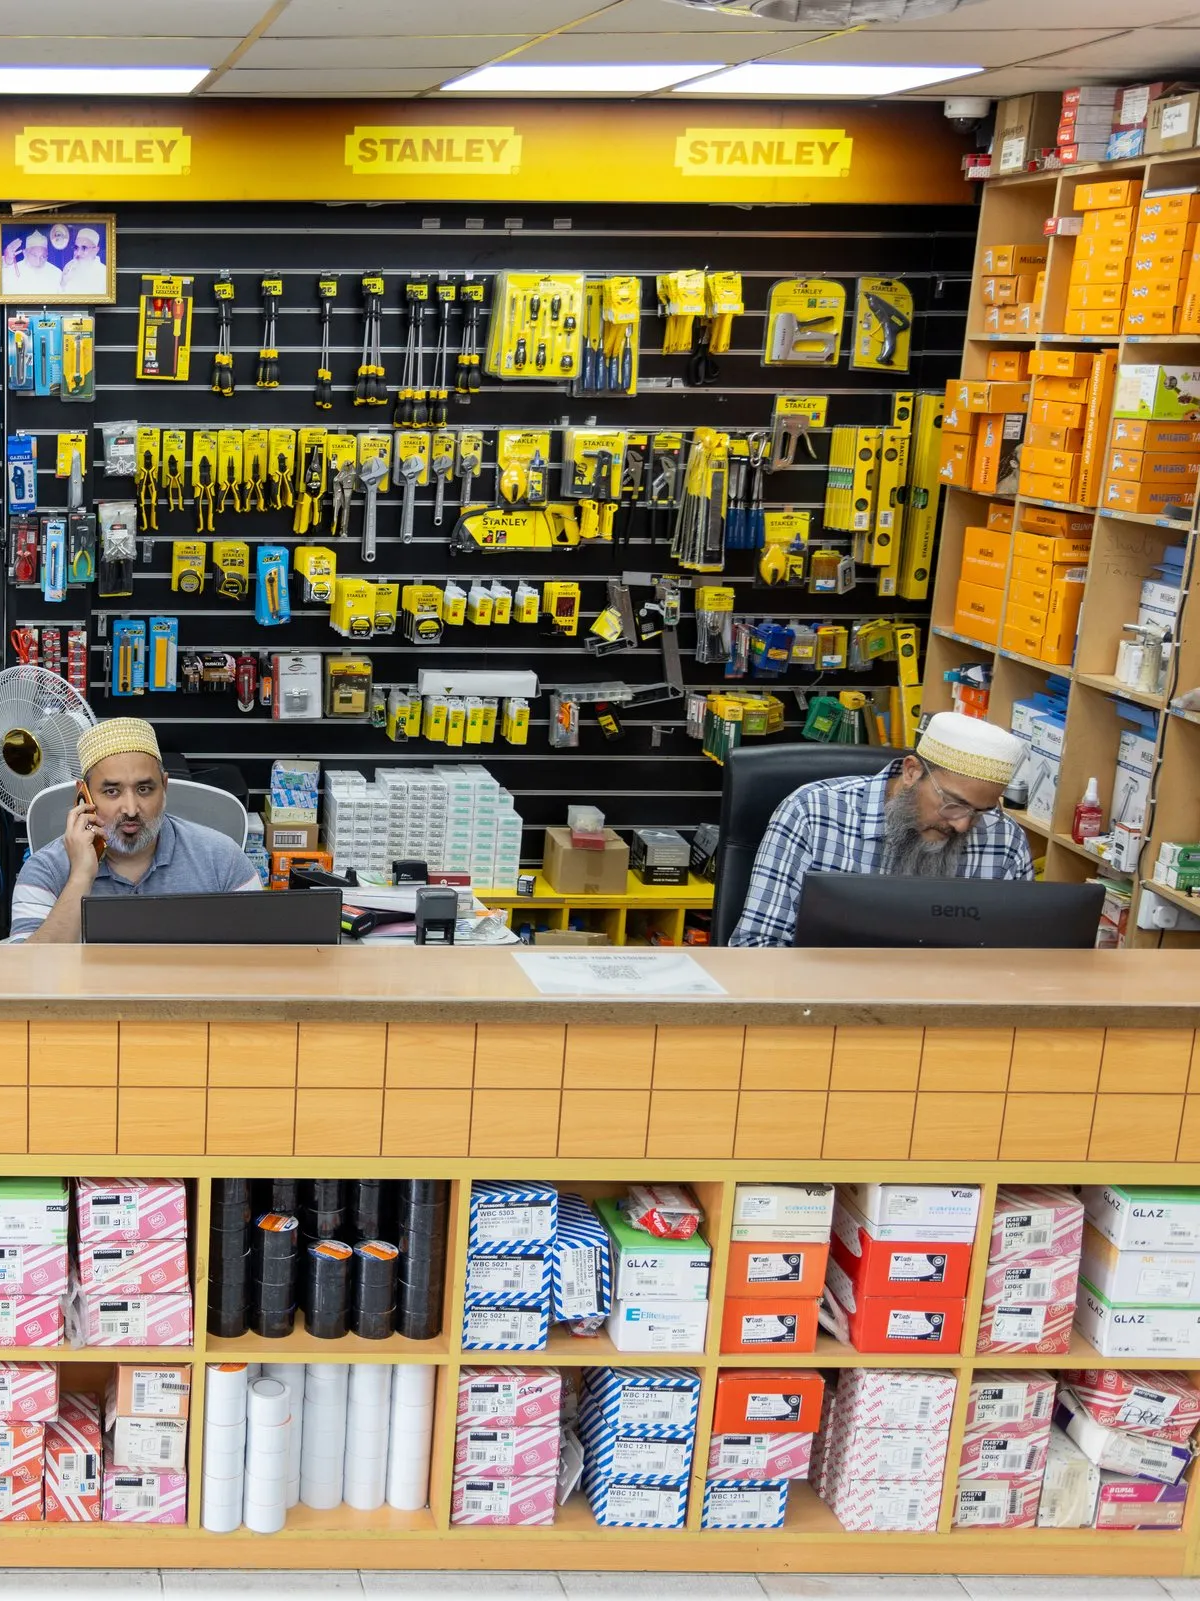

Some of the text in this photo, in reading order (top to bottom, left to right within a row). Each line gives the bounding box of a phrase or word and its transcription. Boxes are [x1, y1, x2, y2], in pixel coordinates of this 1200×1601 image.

[28, 139, 178, 164] STANLEY
[358, 137, 509, 163] STANLEY
[688, 139, 840, 166] STANLEY
[871, 285, 898, 293] STANLEY
[482, 517, 527, 527] STANLEY
[480, 1201, 506, 1209] Panasonic
[868, 1384, 885, 1398] tenby
[936, 1386, 954, 1400] tenby
[866, 1399, 883, 1413] tenby
